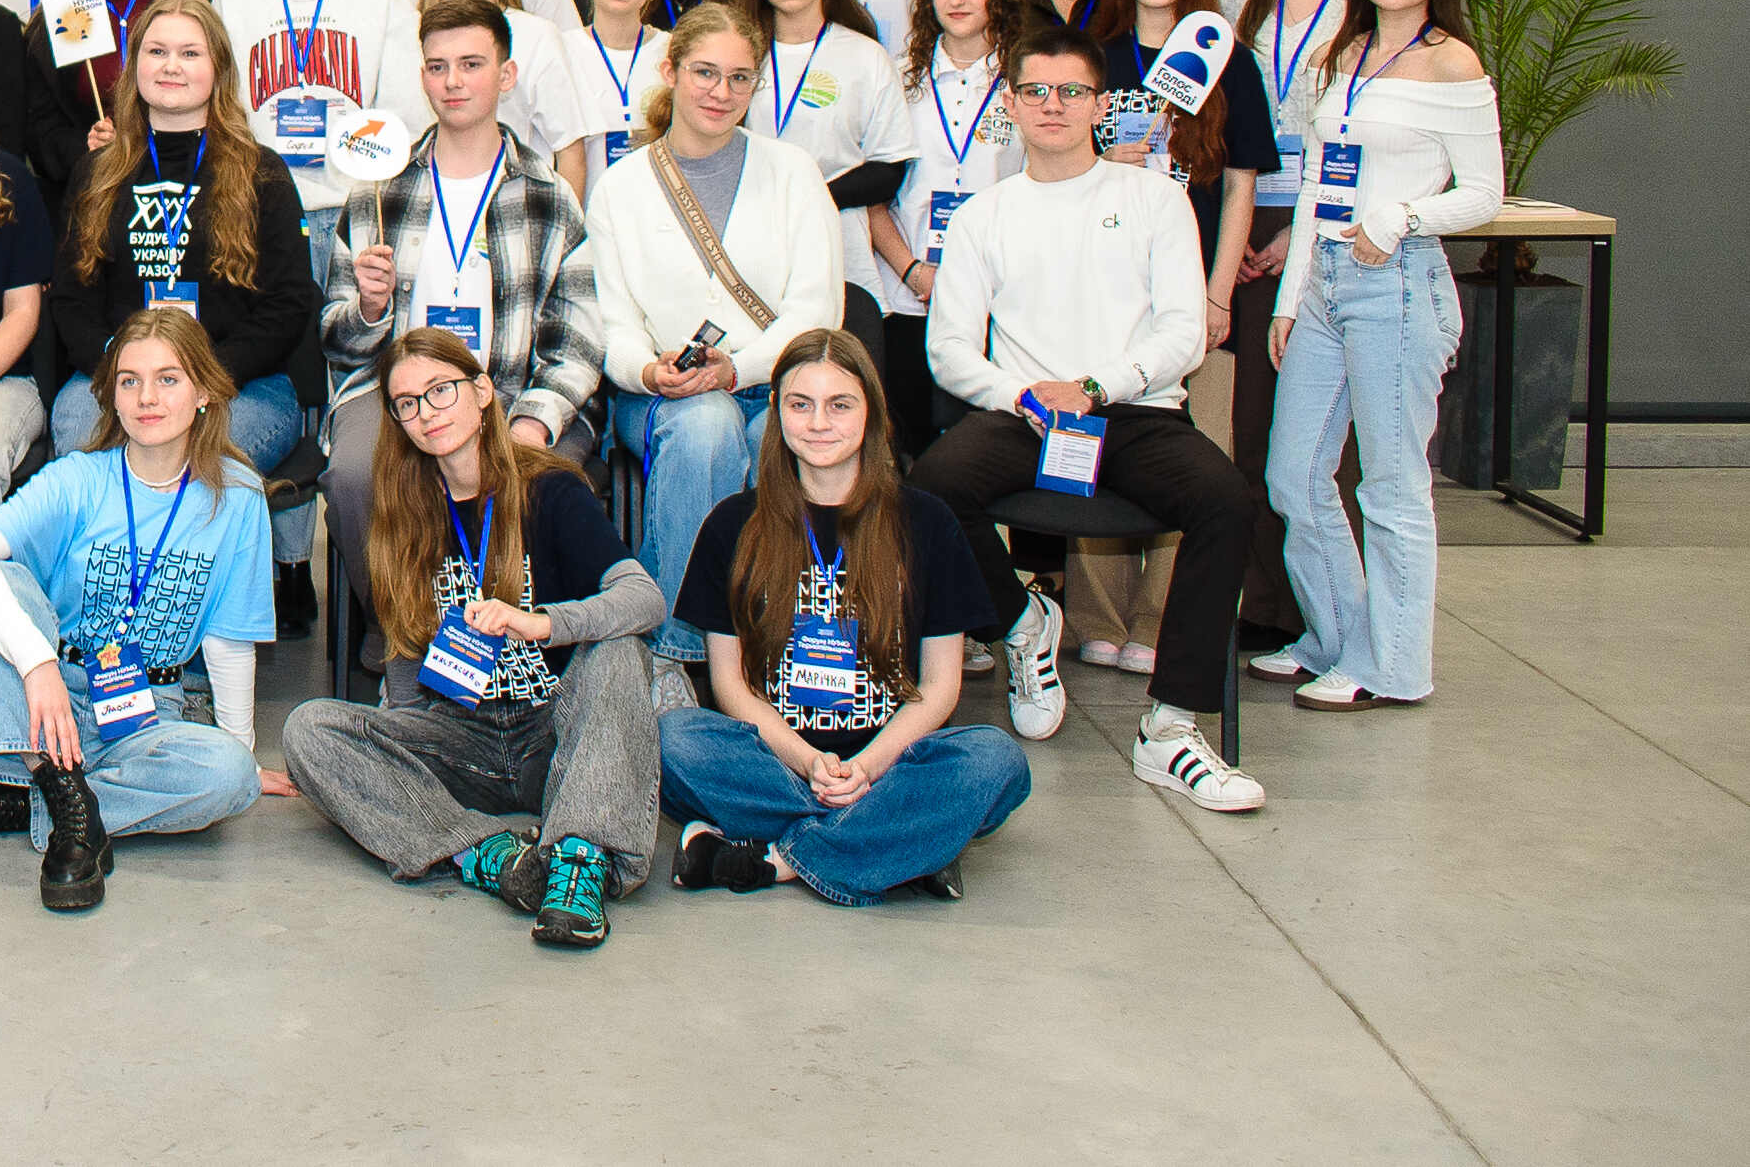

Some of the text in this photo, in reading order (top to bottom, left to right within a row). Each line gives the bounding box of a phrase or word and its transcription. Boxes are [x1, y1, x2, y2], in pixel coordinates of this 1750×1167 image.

[250, 27, 363, 112] CALIFORNIA
[1156, 67, 1193, 93] Голос
[1152, 77, 1197, 107] молоді
[338, 138, 377, 160] участь
[340, 130, 391, 155] Активна
[130, 232, 190, 246] БУДУЄО
[133, 247, 185, 261] УКРАЇУ
[795, 669, 847, 688] МАРІЧКА
